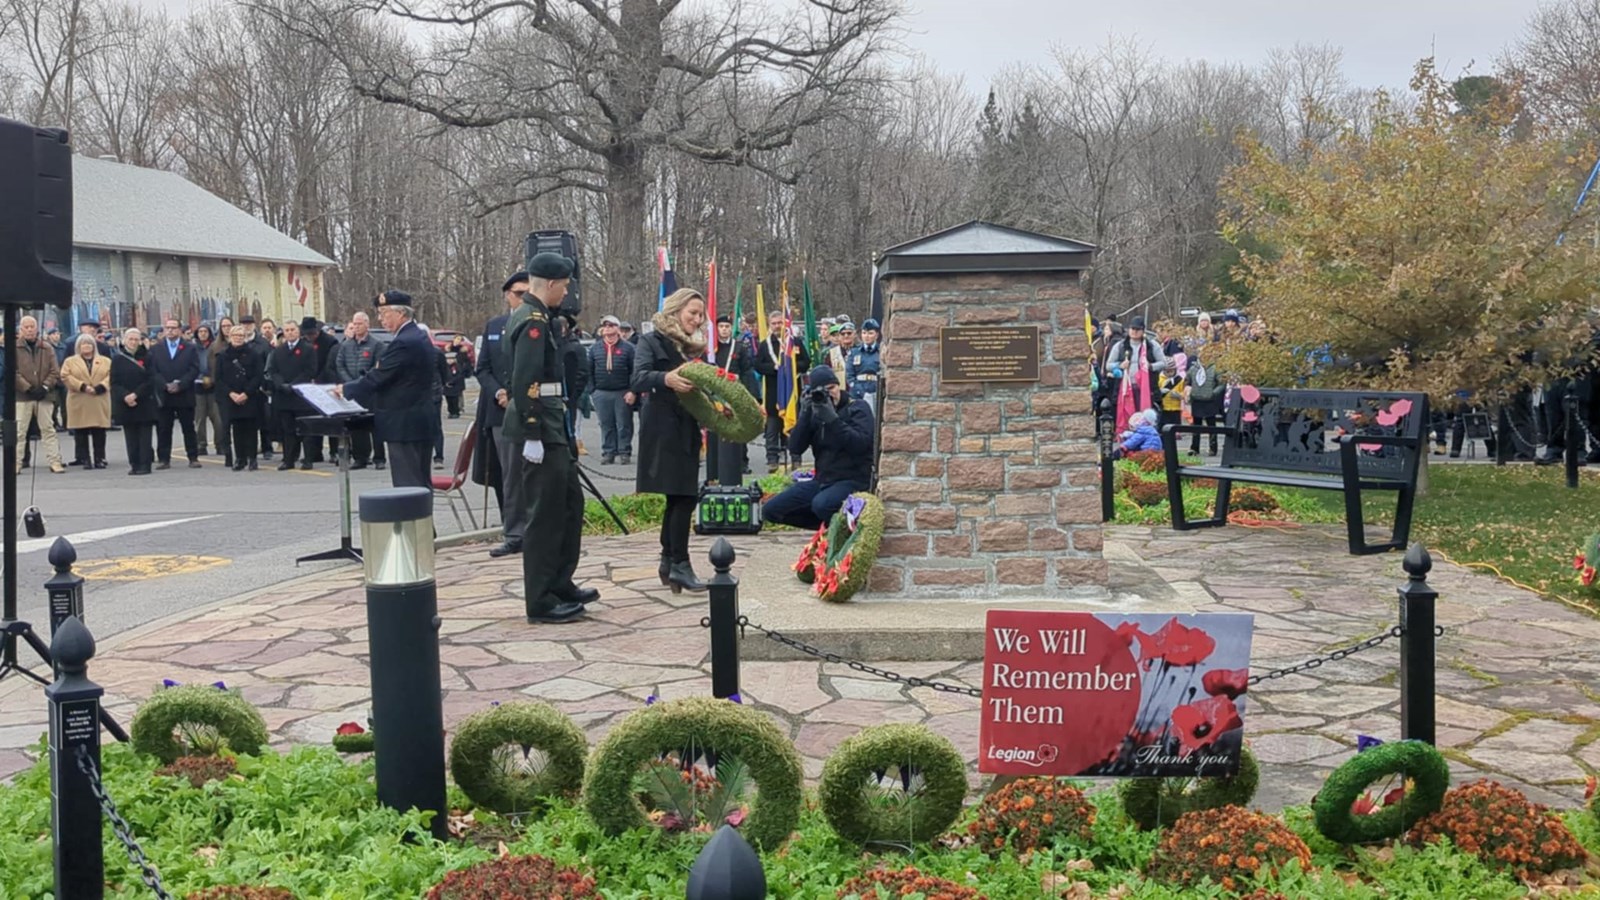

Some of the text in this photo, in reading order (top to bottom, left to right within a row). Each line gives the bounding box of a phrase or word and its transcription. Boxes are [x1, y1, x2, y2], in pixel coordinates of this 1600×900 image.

[992, 627, 1086, 655] We Will
[991, 663, 1137, 690] Remember
[989, 697, 1063, 724] Them
[988, 745, 1036, 762] Legion
[1135, 744, 1229, 771] Thank you
